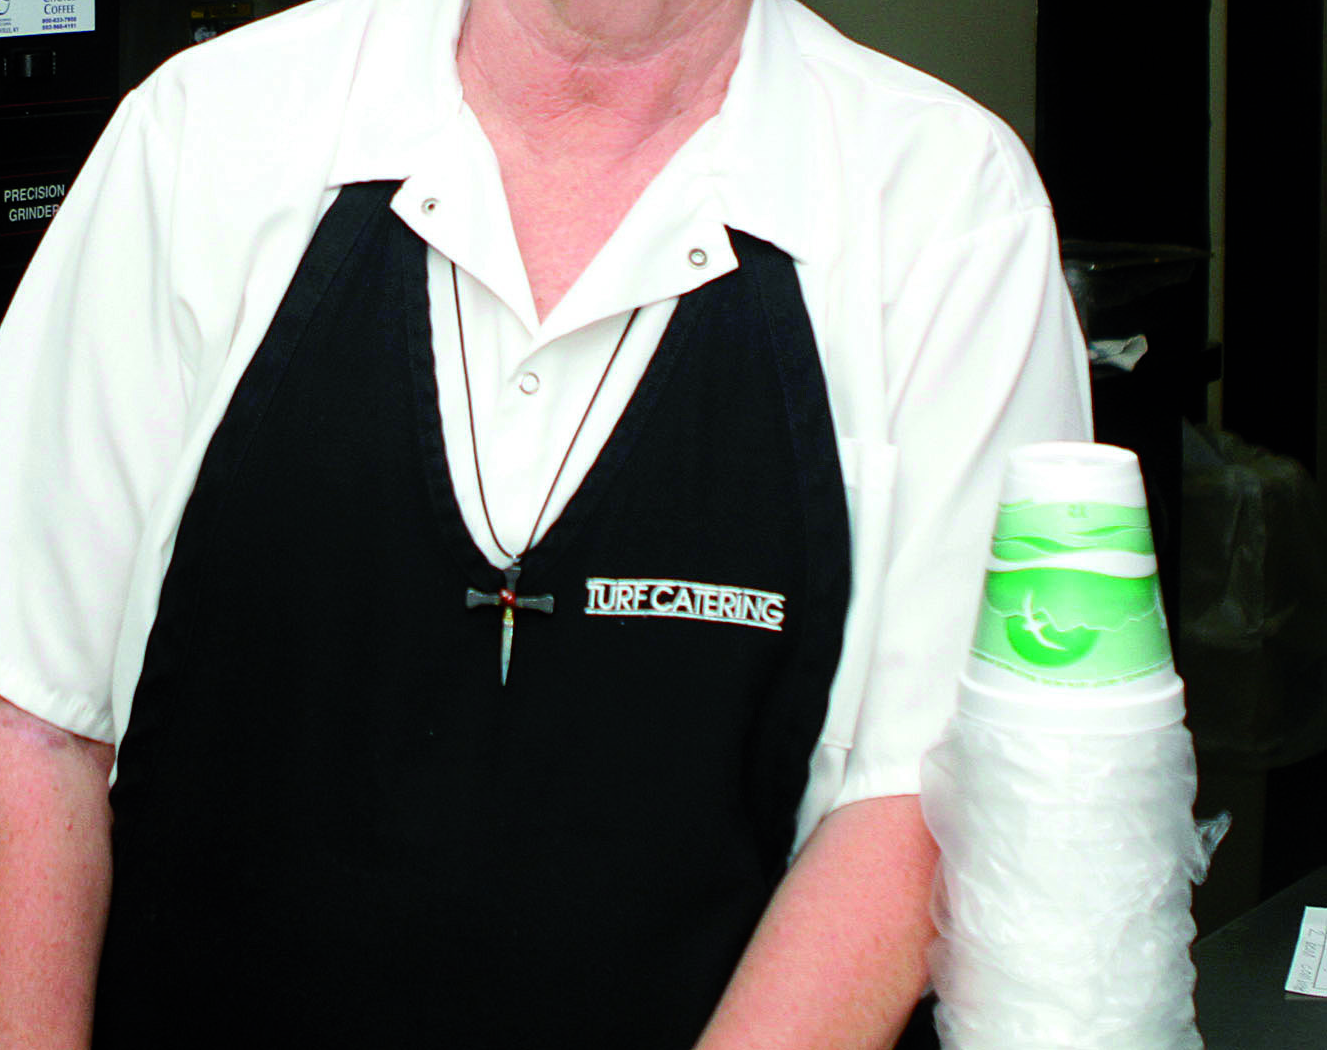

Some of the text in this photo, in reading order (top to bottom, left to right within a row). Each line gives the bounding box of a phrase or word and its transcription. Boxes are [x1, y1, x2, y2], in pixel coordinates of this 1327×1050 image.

[44, 4, 75, 15] COFFEE
[4, 185, 65, 202] PRECISION
[9, 204, 60, 222] GRINDER
[587, 585, 785, 624] TURF CATERING
